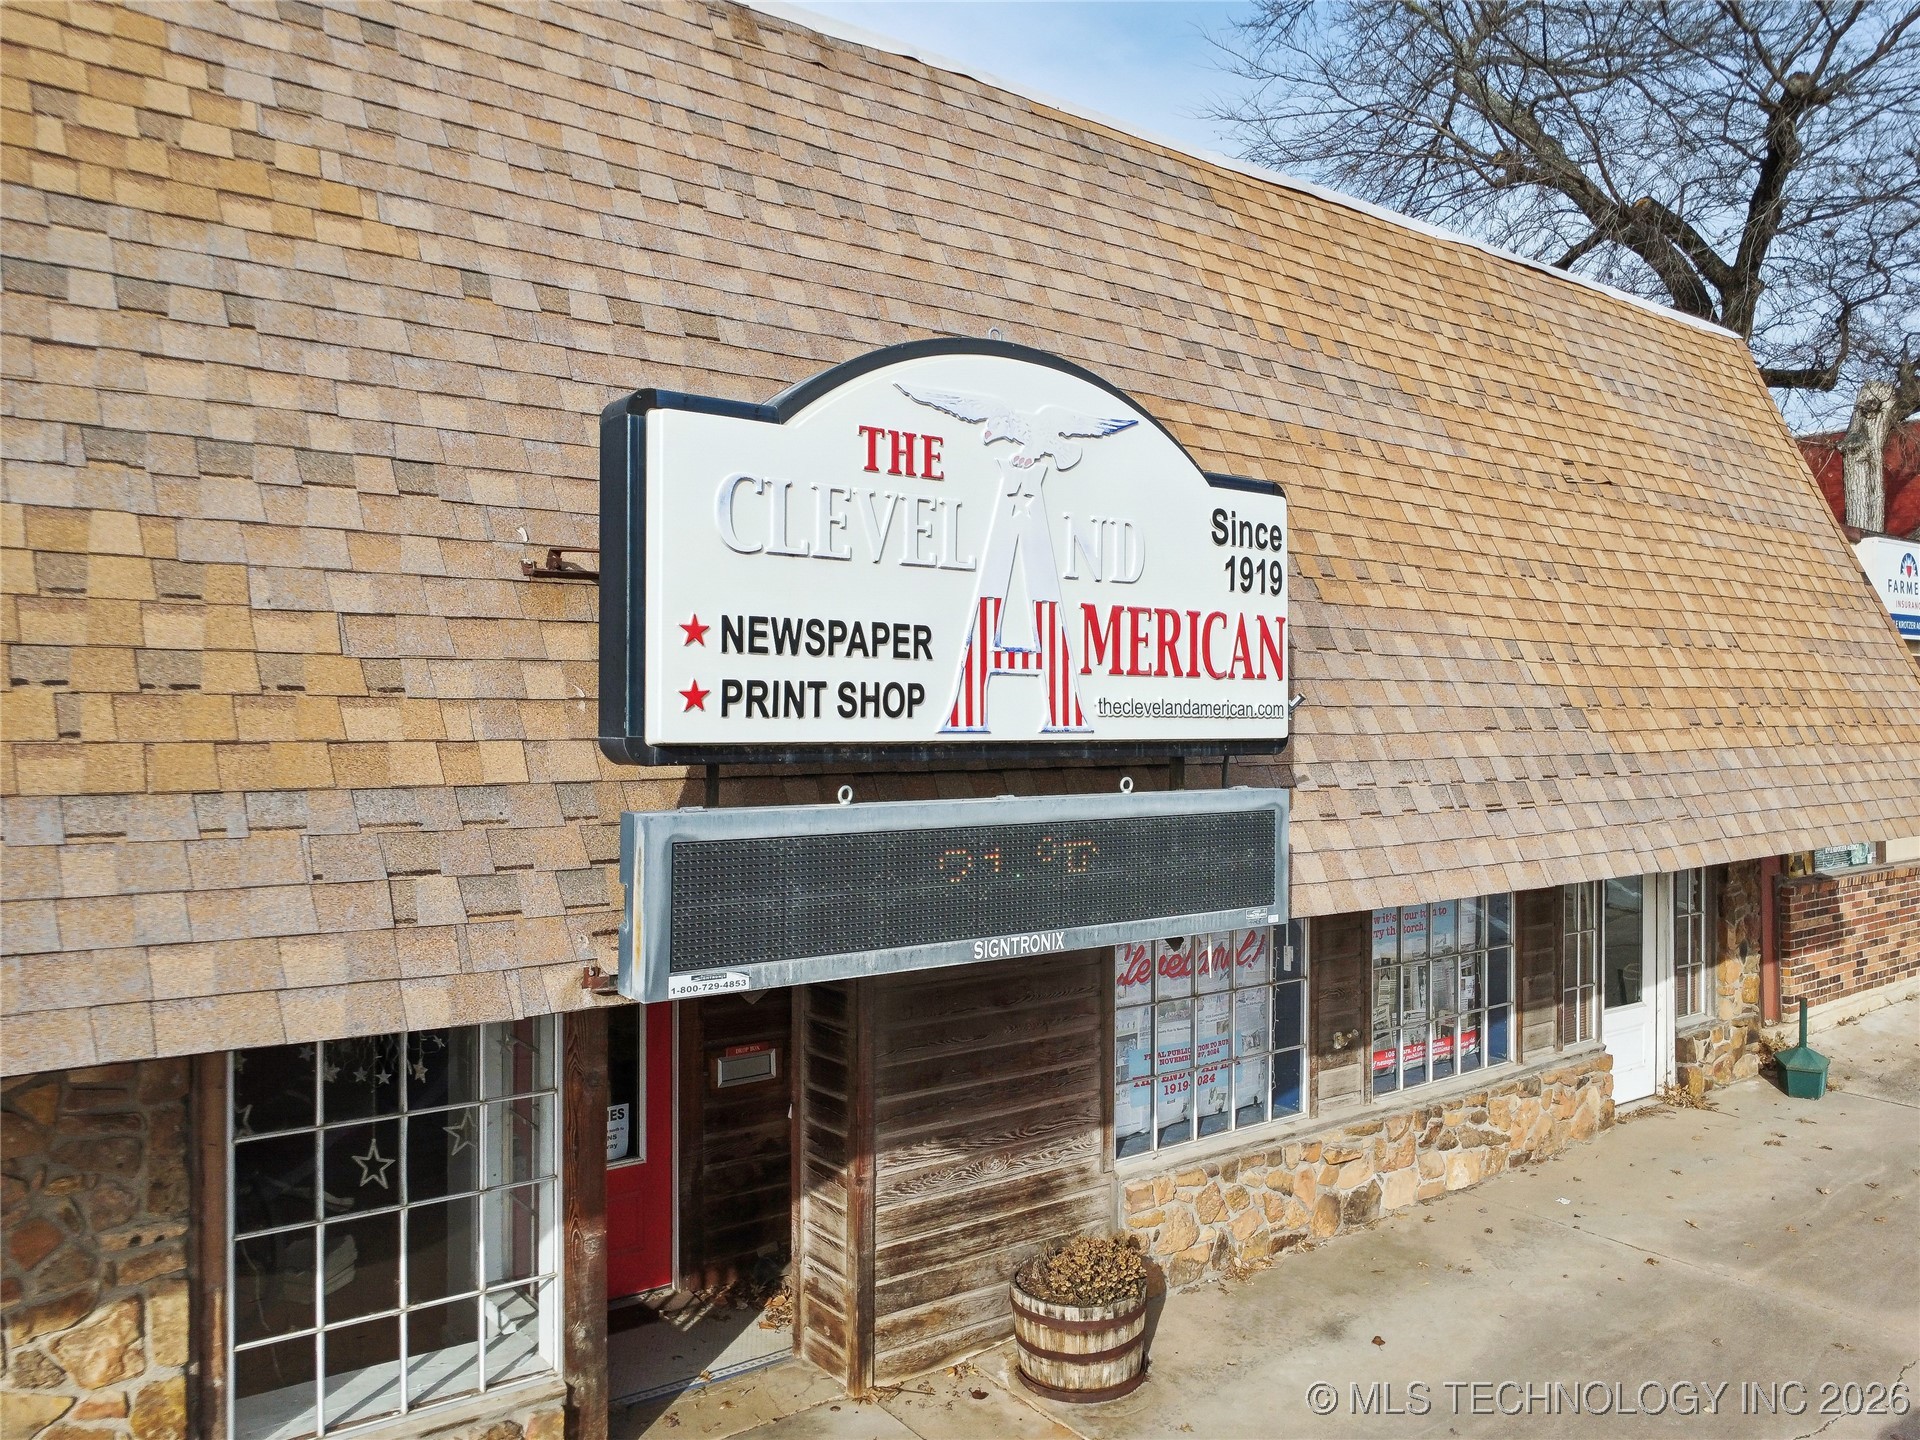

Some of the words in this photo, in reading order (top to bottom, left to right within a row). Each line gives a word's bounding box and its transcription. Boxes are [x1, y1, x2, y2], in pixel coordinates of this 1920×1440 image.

[858, 424, 945, 481] THE
[713, 464, 1146, 585] CLEVELAND
[1211, 508, 1283, 551] Since
[1224, 555, 1283, 596] 1919
[1887, 579, 1919, 596] FARME
[721, 614, 933, 660] NEWSPAPER
[721, 679, 827, 719] PRINT
[837, 681, 925, 718] SHOP
[1098, 698, 1284, 719] theclevelandamerican.com
[1381, 912, 1397, 924] it's
[1403, 911, 1419, 921] our
[1438, 907, 1447, 916] to
[1385, 925, 1397, 936] th
[973, 931, 1065, 960] SIGNTRONIX
[671, 979, 747, 994] 1-800-729-4853
[1144, 1050, 1166, 1061] FIAL
[1164, 1073, 1216, 1096] 1919-024
